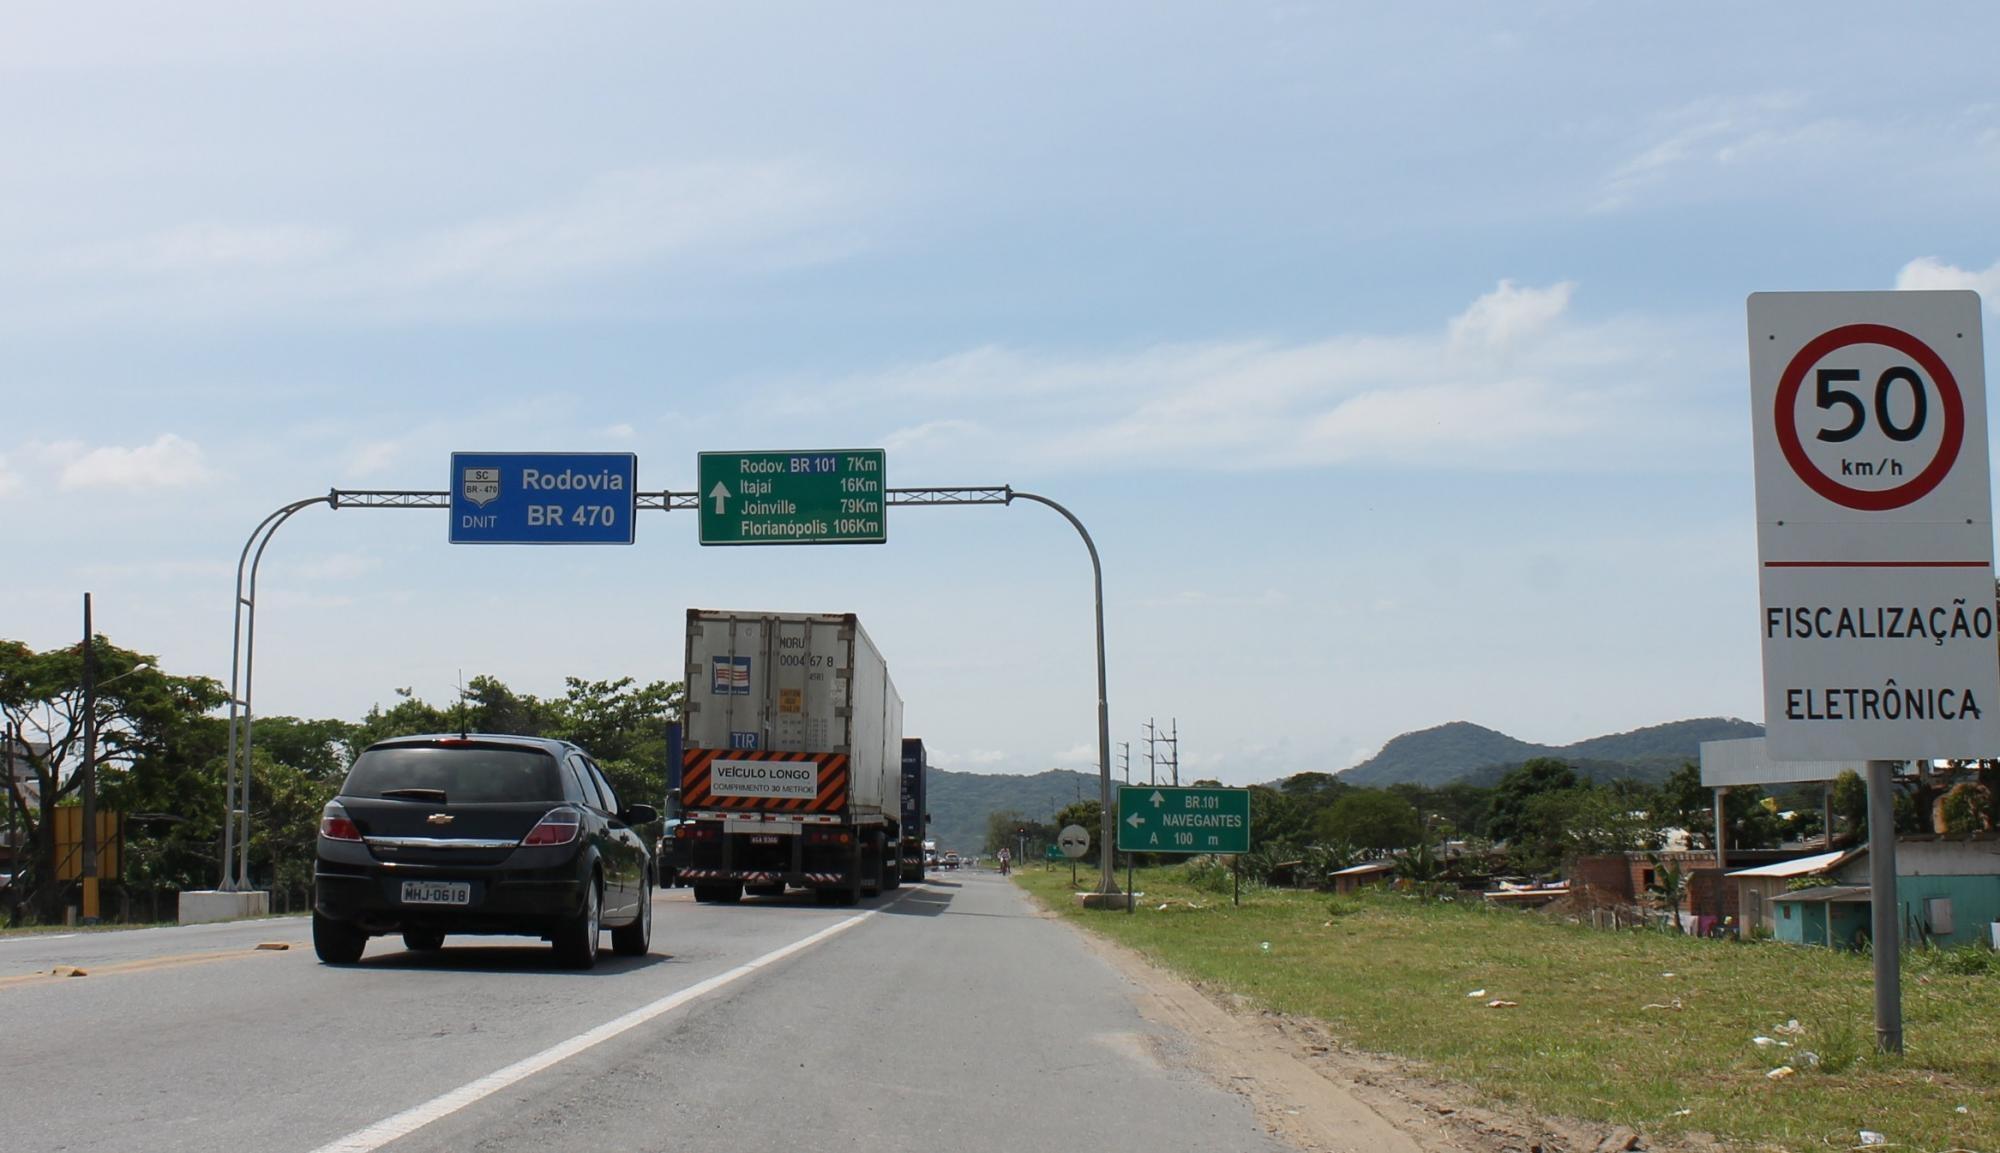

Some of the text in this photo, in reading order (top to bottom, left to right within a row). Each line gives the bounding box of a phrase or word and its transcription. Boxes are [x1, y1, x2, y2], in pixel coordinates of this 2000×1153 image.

[1816, 366, 1927, 443] 50
[740, 457, 877, 473] Rodov. BR 101 7Km
[1841, 458, 1903, 476] km/h
[475, 471, 489, 480] SC
[522, 469, 623, 490] Rodovia
[466, 486, 479, 494] BR
[484, 485, 498, 494] 470
[740, 477, 877, 497] Itajaí 16Km
[740, 499, 878, 515] Joinville 79Km
[462, 515, 497, 528] DNIT
[527, 505, 615, 526] BR 470
[741, 518, 878, 538] Florianópolis 106Km
[1766, 598, 1992, 646] FISCALIZAÇÃO
[826, 656, 834, 667] 8
[1786, 679, 1981, 720] ELETRÔNICA
[733, 734, 755, 748] TIR
[717, 766, 810, 780] VEÍCULO LONGO
[713, 783, 814, 794] COMPRIMENTO 30 METROS
[1163, 814, 1242, 828] NAVEGANTES
[1150, 832, 1219, 846] A 100 m
[405, 888, 466, 902] MHJ-0618
